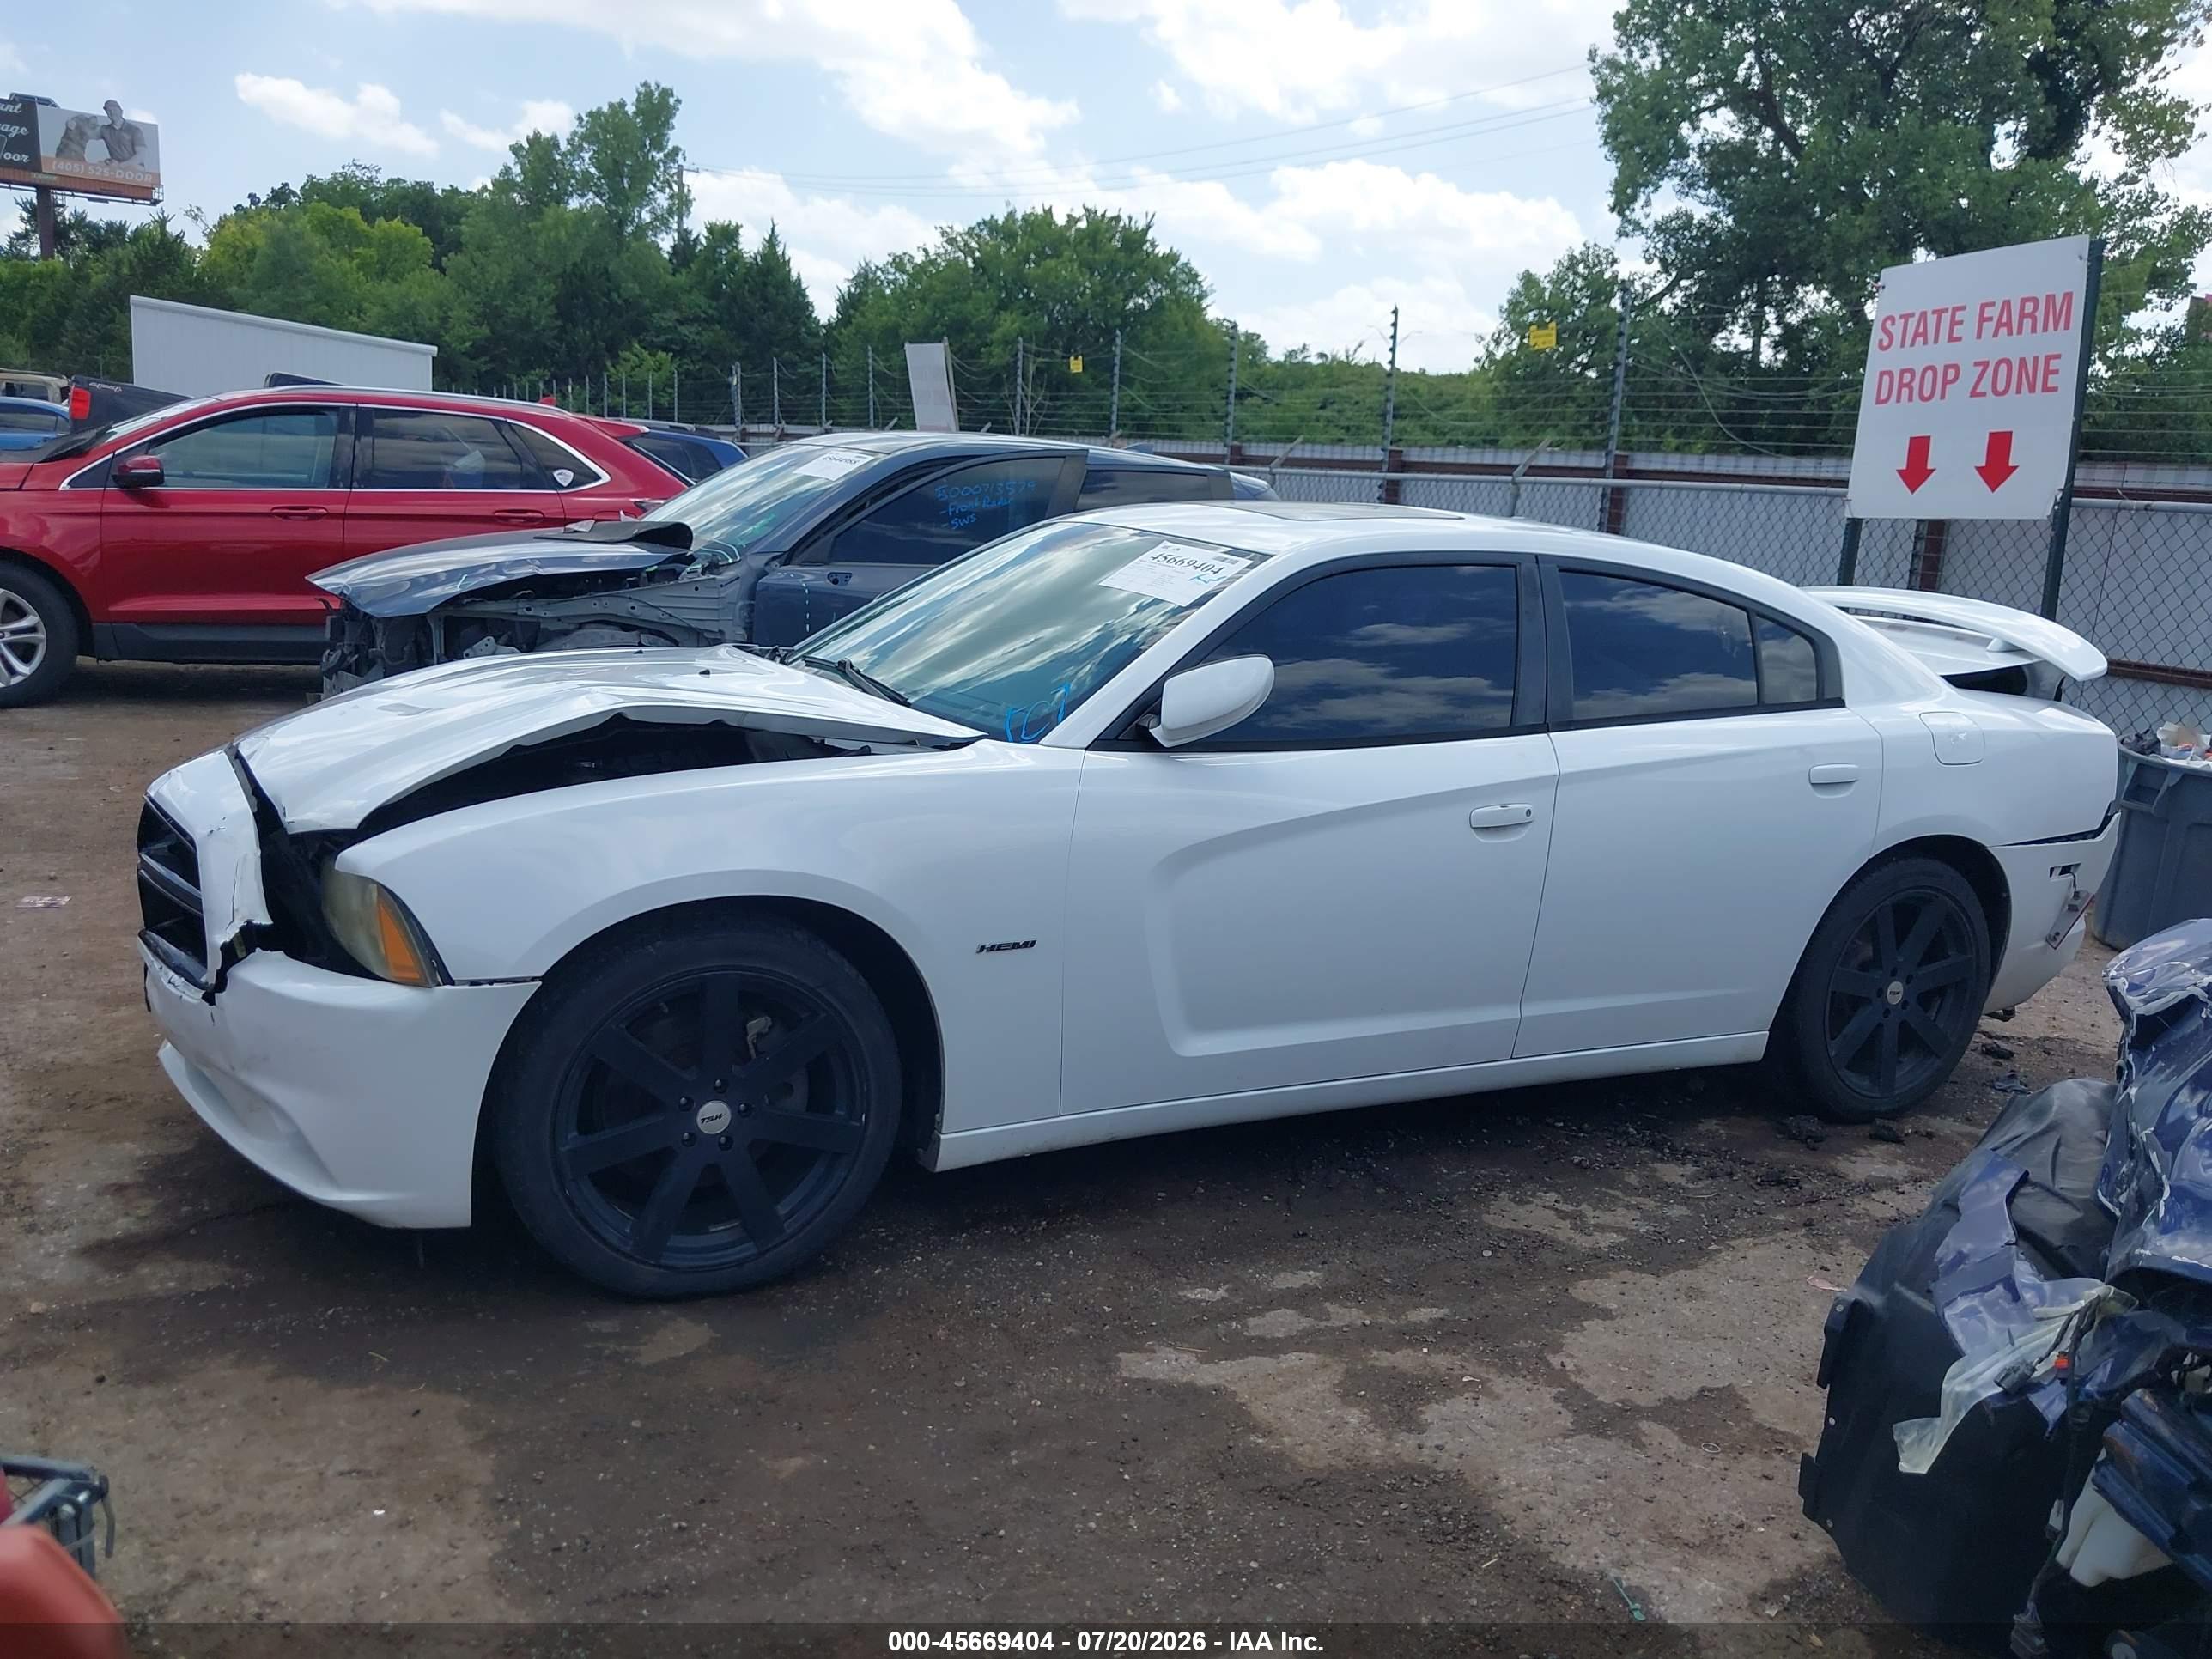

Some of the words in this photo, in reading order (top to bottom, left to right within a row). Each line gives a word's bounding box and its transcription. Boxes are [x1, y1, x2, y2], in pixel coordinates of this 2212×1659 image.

[52, 161, 84, 174] (405)
[88, 166, 152, 181] 525-DOOR
[1877, 305, 1966, 351] STATE
[1975, 291, 2073, 340] FARM
[1875, 363, 1960, 405] DROP
[1970, 353, 2062, 398] ZONE
[1151, 553, 1225, 574] 45669404
[976, 940, 1036, 953] HEMI
